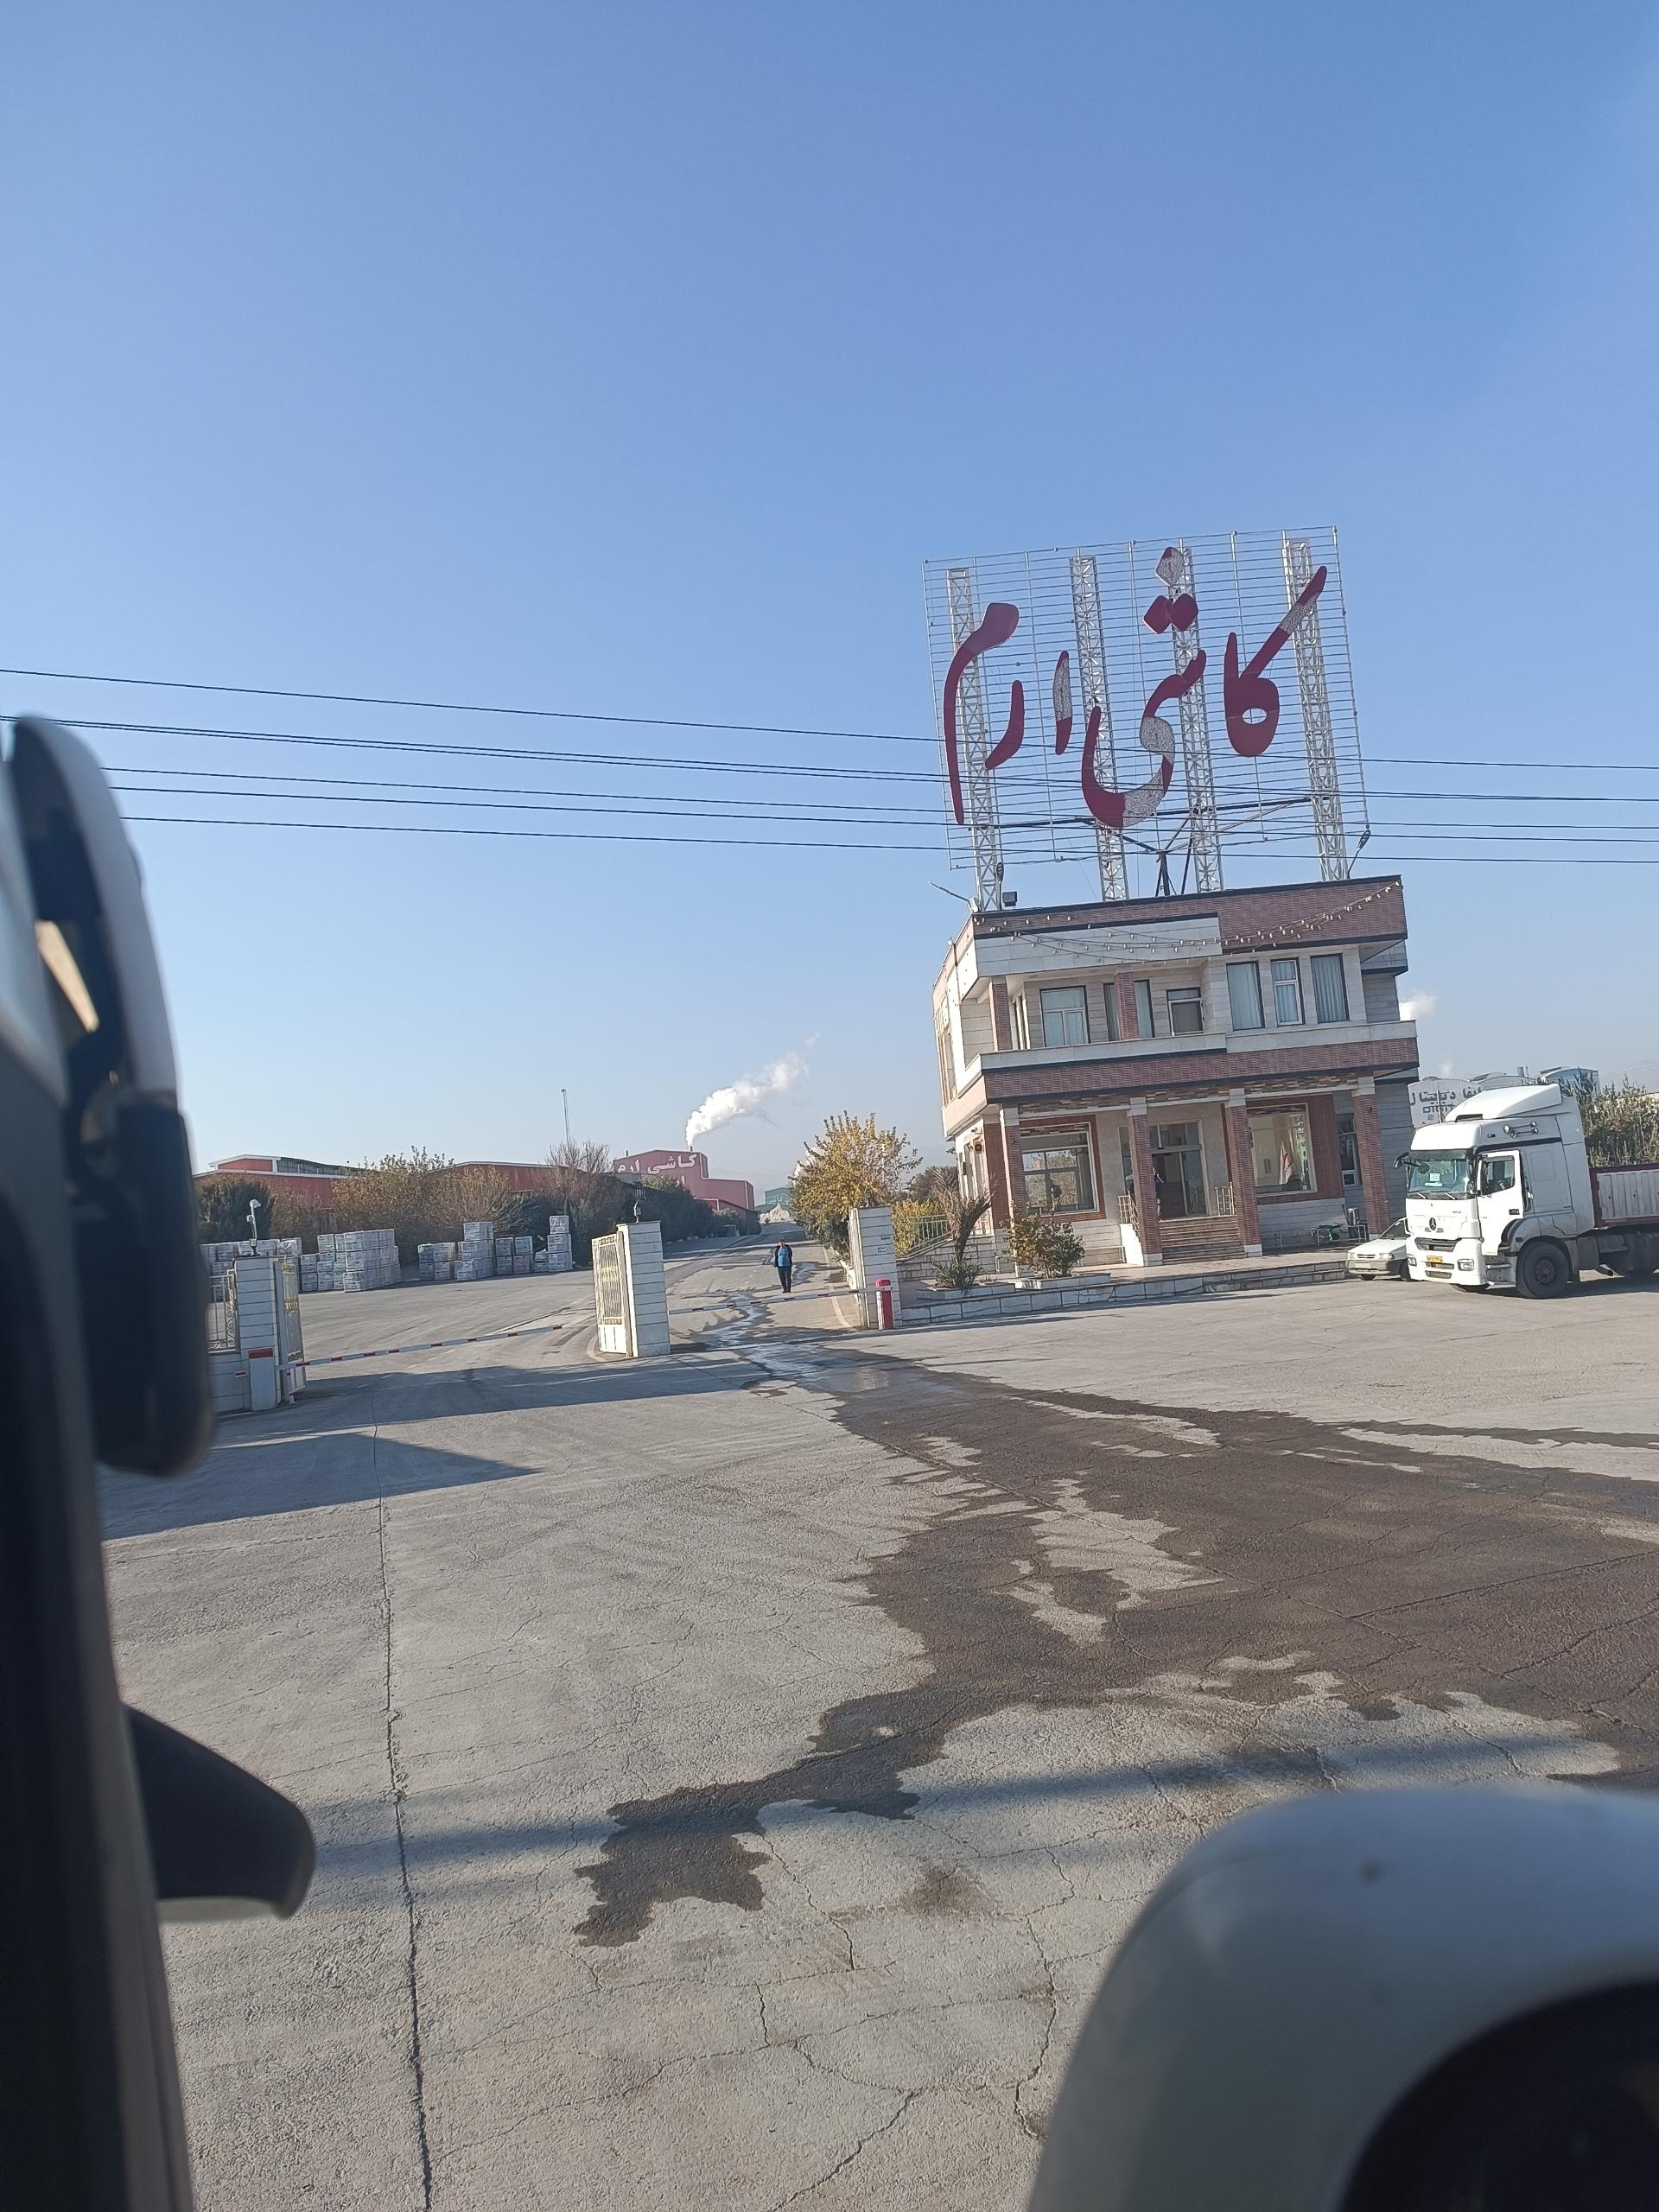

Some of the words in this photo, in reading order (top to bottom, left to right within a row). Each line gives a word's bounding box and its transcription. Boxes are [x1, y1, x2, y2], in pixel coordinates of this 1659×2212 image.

[944, 603, 1072, 824] ارم
[1082, 547, 1327, 828] کاشی
[617, 1159, 640, 1173] ارم
[647, 1154, 697, 1174] کاشی
